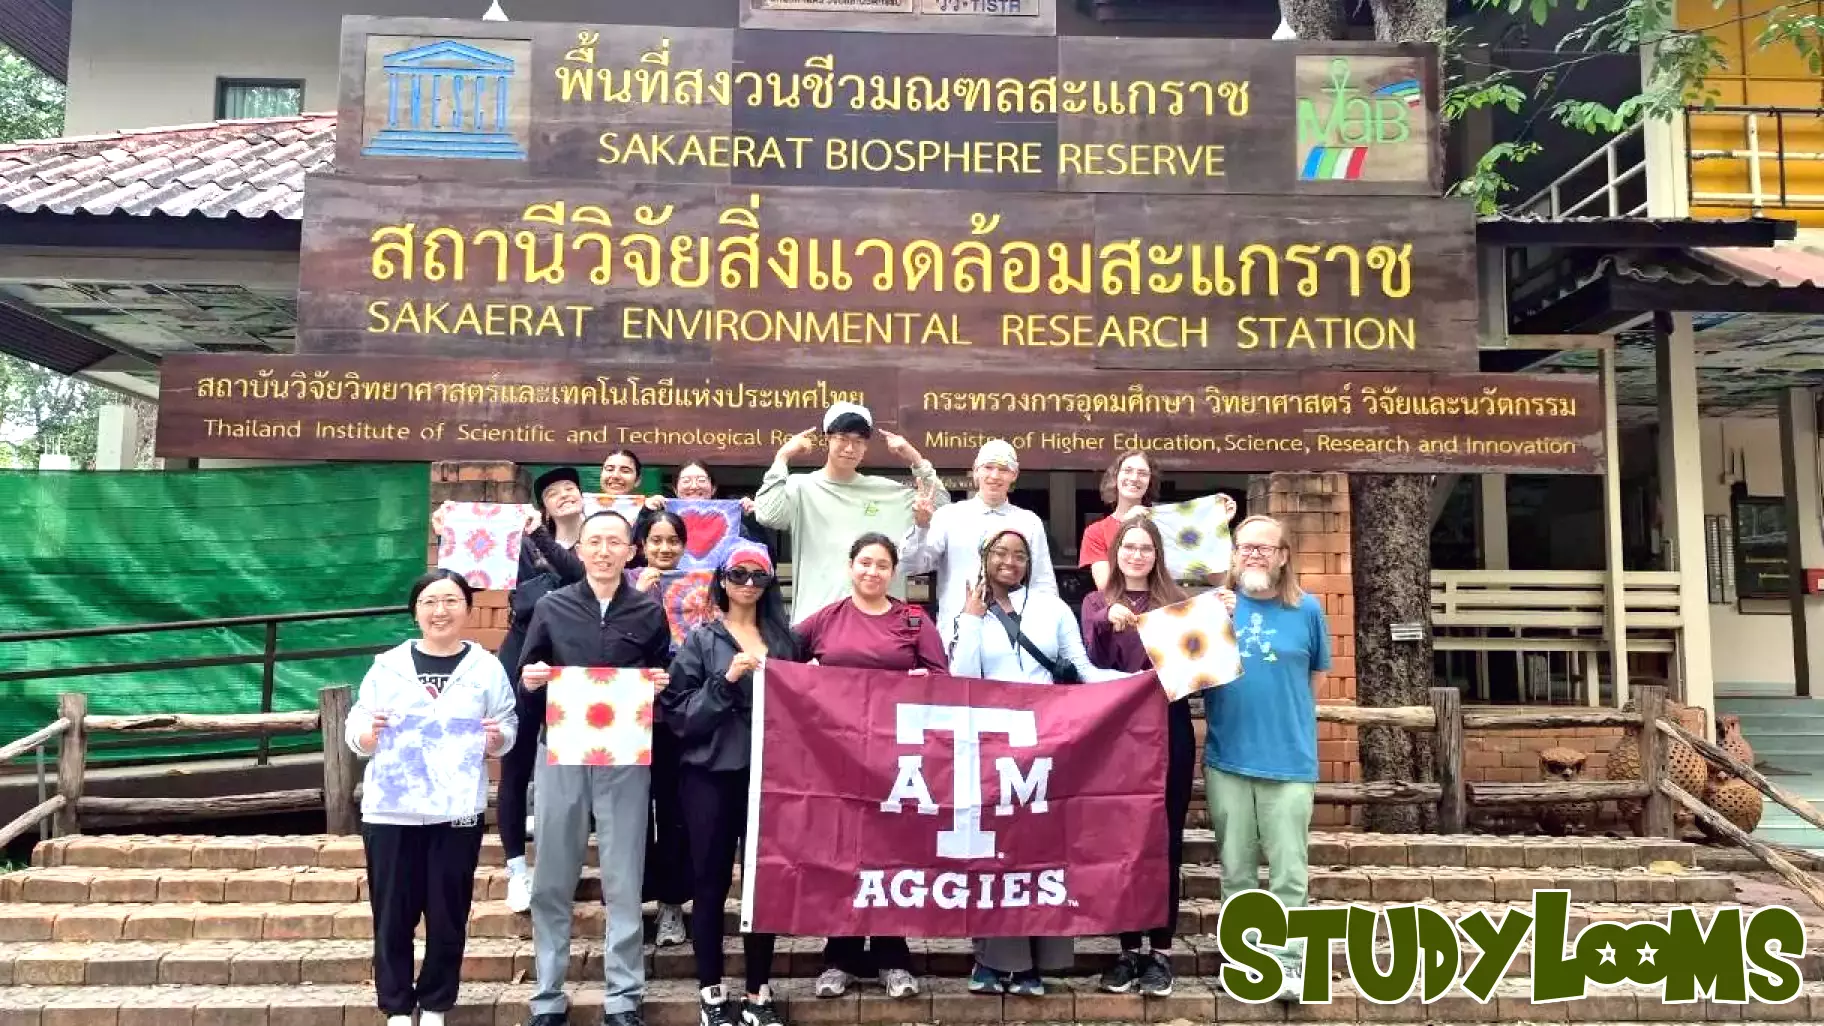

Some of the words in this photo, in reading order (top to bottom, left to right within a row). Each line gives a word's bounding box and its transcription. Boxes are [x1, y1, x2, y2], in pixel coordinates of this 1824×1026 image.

[554, 28, 1251, 118] พื้นที่สงวนชีวมณฑลสะแกราช
[597, 130, 814, 170] SAKAERAT
[825, 136, 1043, 176] BIOSPHERE
[1057, 139, 1226, 177] RESERVE
[368, 193, 1414, 300] สถานีวิจัยสิ่งแวดล้อมสะแกราช
[366, 299, 594, 339] SAKAERAT
[621, 305, 973, 346] ENVIRONMENTAL
[1000, 310, 1209, 350] RESEARCH
[1236, 313, 1416, 352] STATION
[922, 383, 1196, 422] กระทรวงการอุดมศึกษา
[1204, 384, 1353, 417] วิทยาศาสตร์
[1360, 385, 1578, 418] วิจัยและนวัตกรรม
[203, 418, 302, 439] Thailand
[314, 421, 412, 442] Institute
[418, 422, 446, 442] of
[456, 423, 556, 444] Scientific
[566, 426, 608, 446] and
[616, 426, 763, 452] Technological
[1011, 430, 1034, 450] of
[1040, 432, 1107, 455] Higher
[1112, 432, 1221, 455] Education,
[1223, 434, 1311, 456] Science,
[1316, 434, 1410, 454] Research
[1417, 436, 1459, 455] and
[1464, 436, 1577, 457] Innovation
[853, 869, 1068, 910] AGGIES
